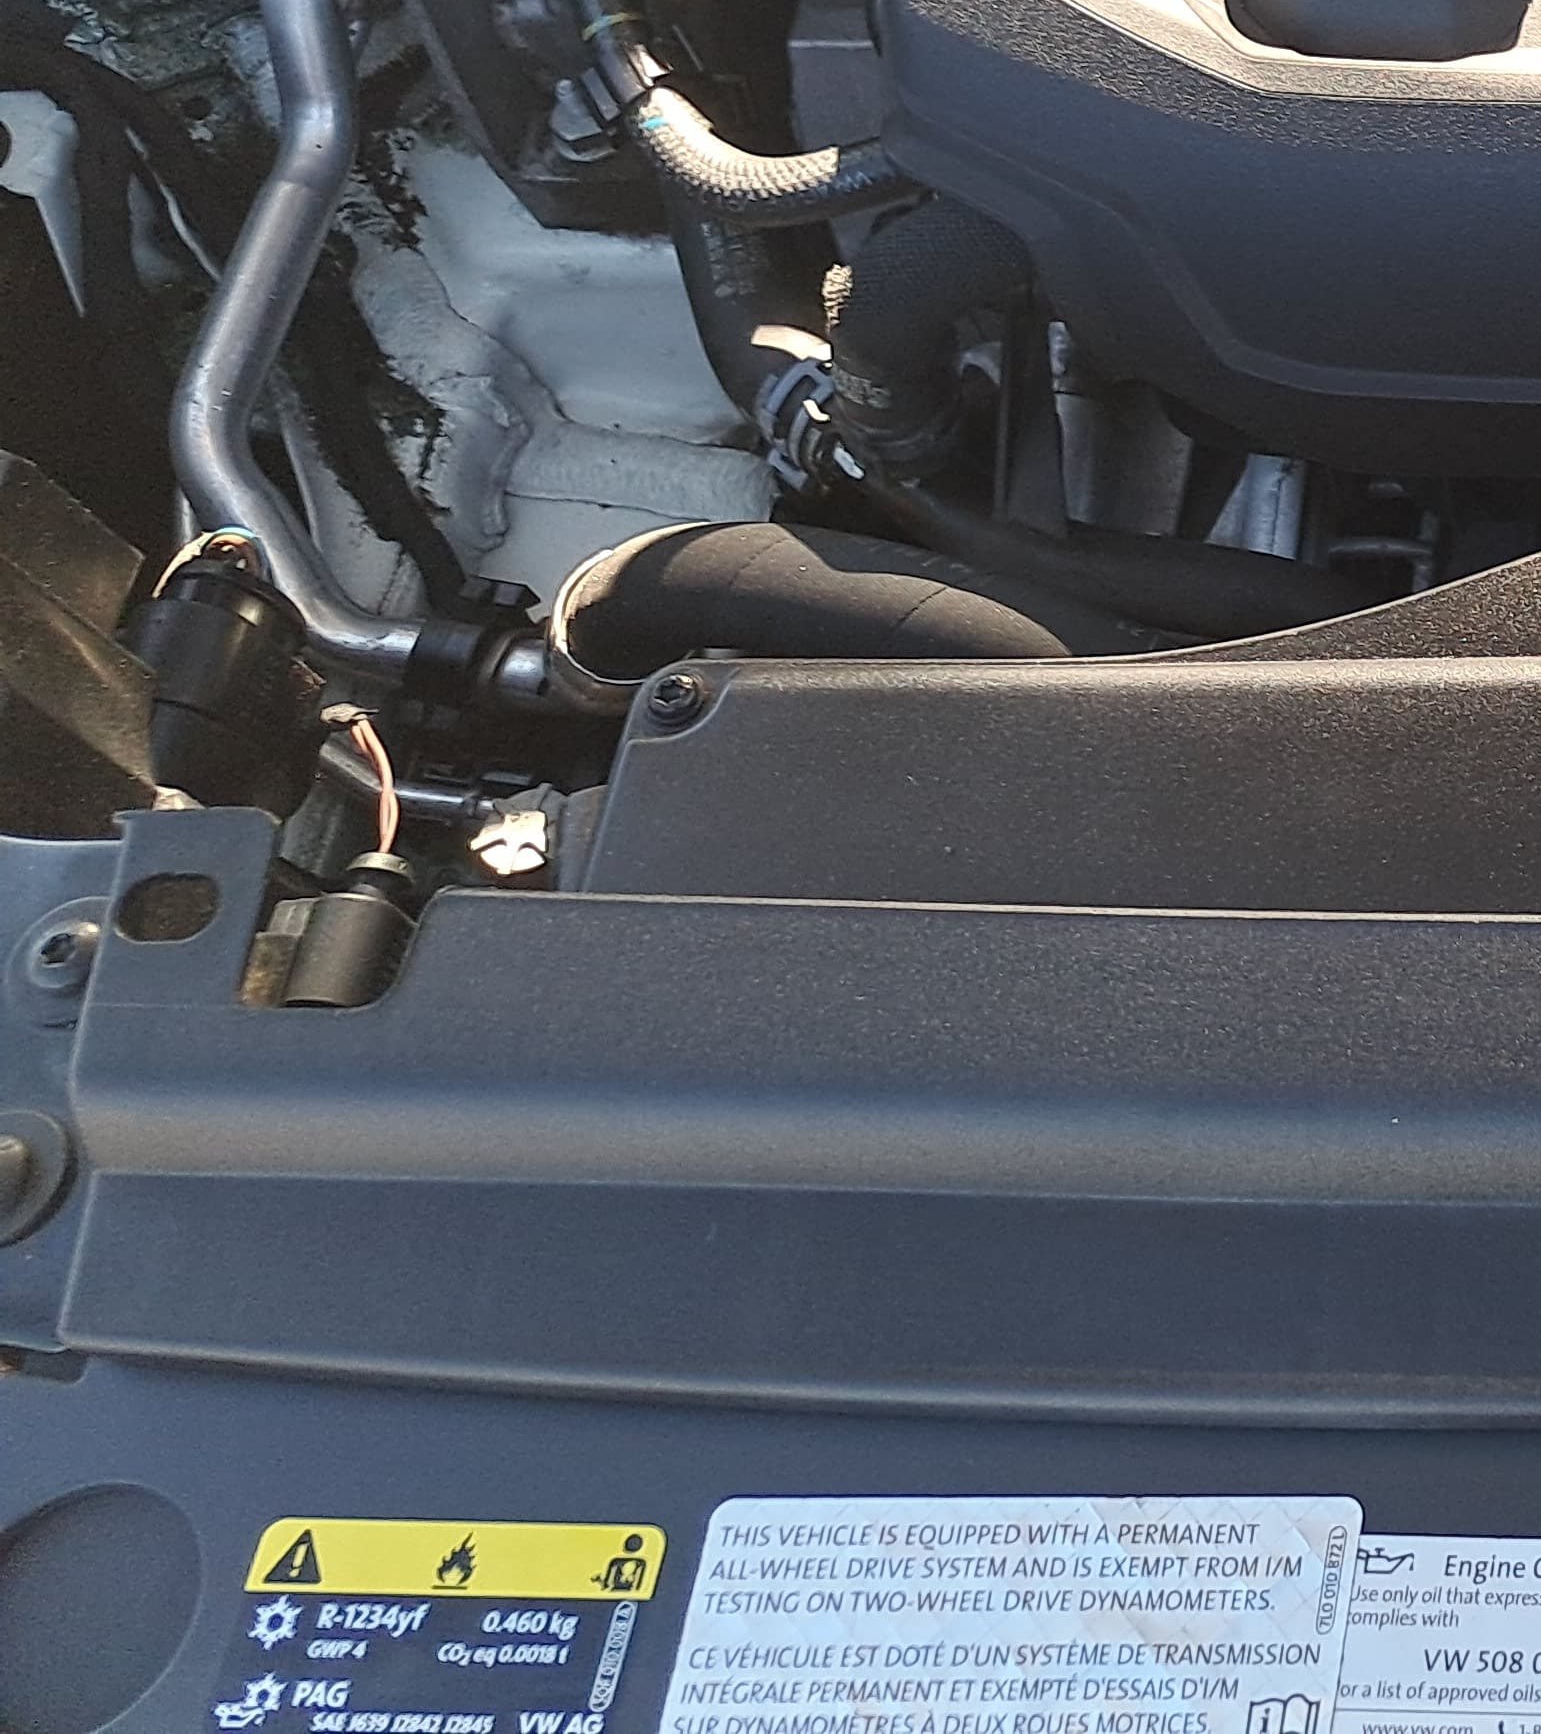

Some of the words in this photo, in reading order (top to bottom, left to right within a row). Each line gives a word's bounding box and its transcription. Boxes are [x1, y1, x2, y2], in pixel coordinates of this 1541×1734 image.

[720, 1524, 771, 1547] THIS
[779, 1524, 874, 1547] VEHICLE
[879, 1524, 898, 1546] IS
[905, 1524, 1021, 1550] EQUIPPED
[1028, 1522, 1089, 1544] WITH
[1094, 1524, 1110, 1544] A
[1117, 1523, 1260, 1545] PERMANENT
[709, 1557, 838, 1581] ALL-WHEEL
[846, 1557, 914, 1579] DRIVE
[921, 1556, 1006, 1578] SYSTEM
[1012, 1557, 1066, 1578] AND
[1073, 1557, 1092, 1578] IS
[1099, 1557, 1190, 1578] EXEMPT
[1194, 1557, 1258, 1578] FROM
[1265, 1555, 1303, 1578] I/M
[1444, 1555, 1526, 1584] Engine
[704, 1590, 800, 1614] TESTING
[806, 1591, 843, 1613] ON
[850, 1590, 995, 1613] TWO-WHEEL
[1003, 1590, 1073, 1612] DRIVE
[1079, 1589, 1276, 1611] DYNAMOMETERS.
[1382, 1587, 1418, 1607] only
[1421, 1587, 1442, 1603] oil
[1446, 1587, 1481, 1605] that
[316, 1603, 429, 1637] R-1234yf
[481, 1610, 545, 1635] 0.460
[548, 1613, 579, 1639] kg
[1422, 1610, 1459, 1627] with
[307, 1639, 349, 1659] GWP
[351, 1640, 367, 1658] 4
[689, 1646, 721, 1670] CE
[725, 1642, 833, 1669] VÉHICULE
[841, 1646, 877, 1668] EST
[885, 1640, 946, 1668] DOTÉ
[951, 1644, 1010, 1667] D'UN
[1015, 1639, 1111, 1666] SYSTÈME
[1117, 1643, 1148, 1665] DE
[1153, 1643, 1322, 1666] TRANSMISSION
[1424, 1648, 1470, 1673] VW
[1476, 1650, 1524, 1674] 508
[292, 1680, 350, 1708] PAG
[680, 1676, 802, 1704] INTÉGRALE
[807, 1681, 944, 1703] PERMANENT
[949, 1680, 975, 1701] ET
[980, 1675, 1077, 1700] EXEMPTÉ
[1083, 1677, 1176, 1700] D'ESSAIS
[1181, 1677, 1239, 1700] D'I/M
[1361, 1685, 1371, 1699] a
[1376, 1681, 1402, 1699] list
[1406, 1681, 1425, 1700] of
[1428, 1682, 1508, 1705] approved
[519, 1711, 562, 1734] VW
[565, 1713, 605, 1734] AG
[673, 1715, 721, 1734] SUR
[727, 1709, 915, 1734] DYNAMOMÈTRES
[921, 1708, 936, 1734] À
[944, 1713, 1009, 1734] DEUX
[1013, 1712, 1093, 1734] ROUES
[1097, 1712, 1212, 1734] MOTRICES.
